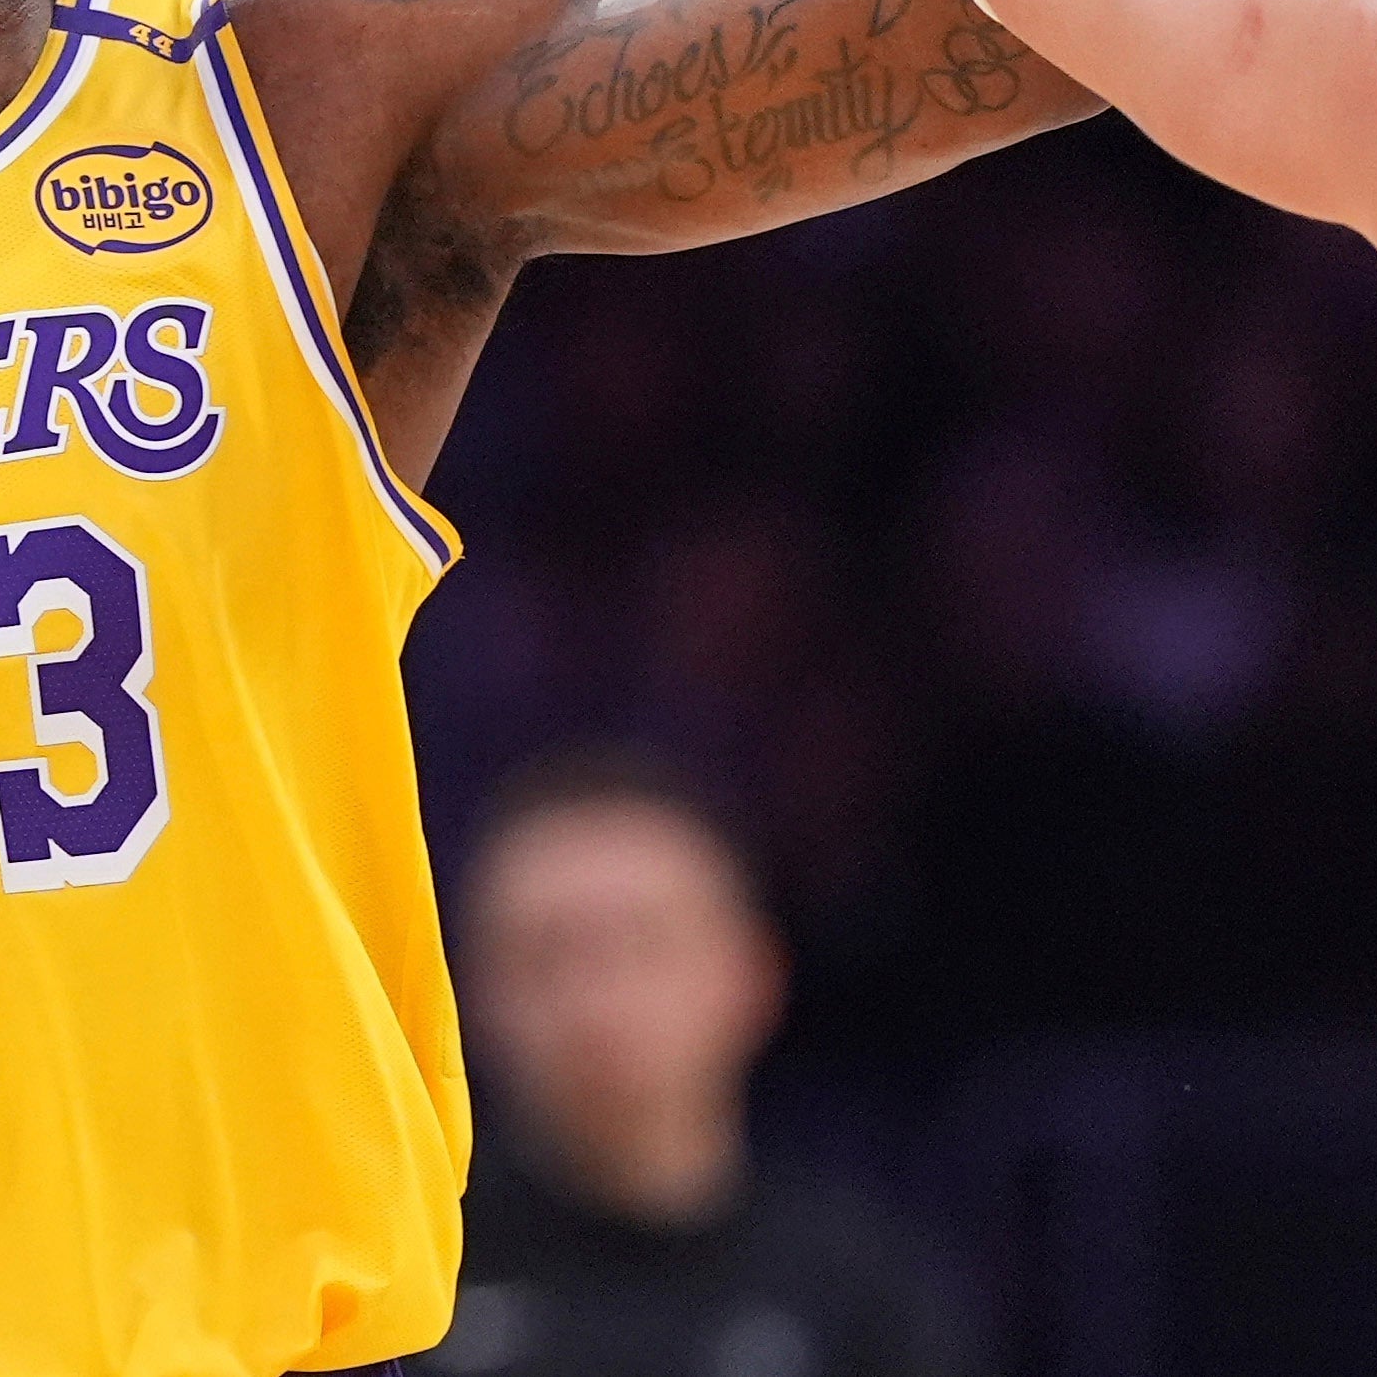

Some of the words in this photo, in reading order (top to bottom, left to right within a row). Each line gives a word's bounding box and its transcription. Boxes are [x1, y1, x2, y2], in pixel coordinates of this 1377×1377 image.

[128, 23, 174, 59] 44
[504, 21, 732, 157] Echoes
[50, 172, 201, 220] bibigo
[82, 211, 146, 232] 비비고
